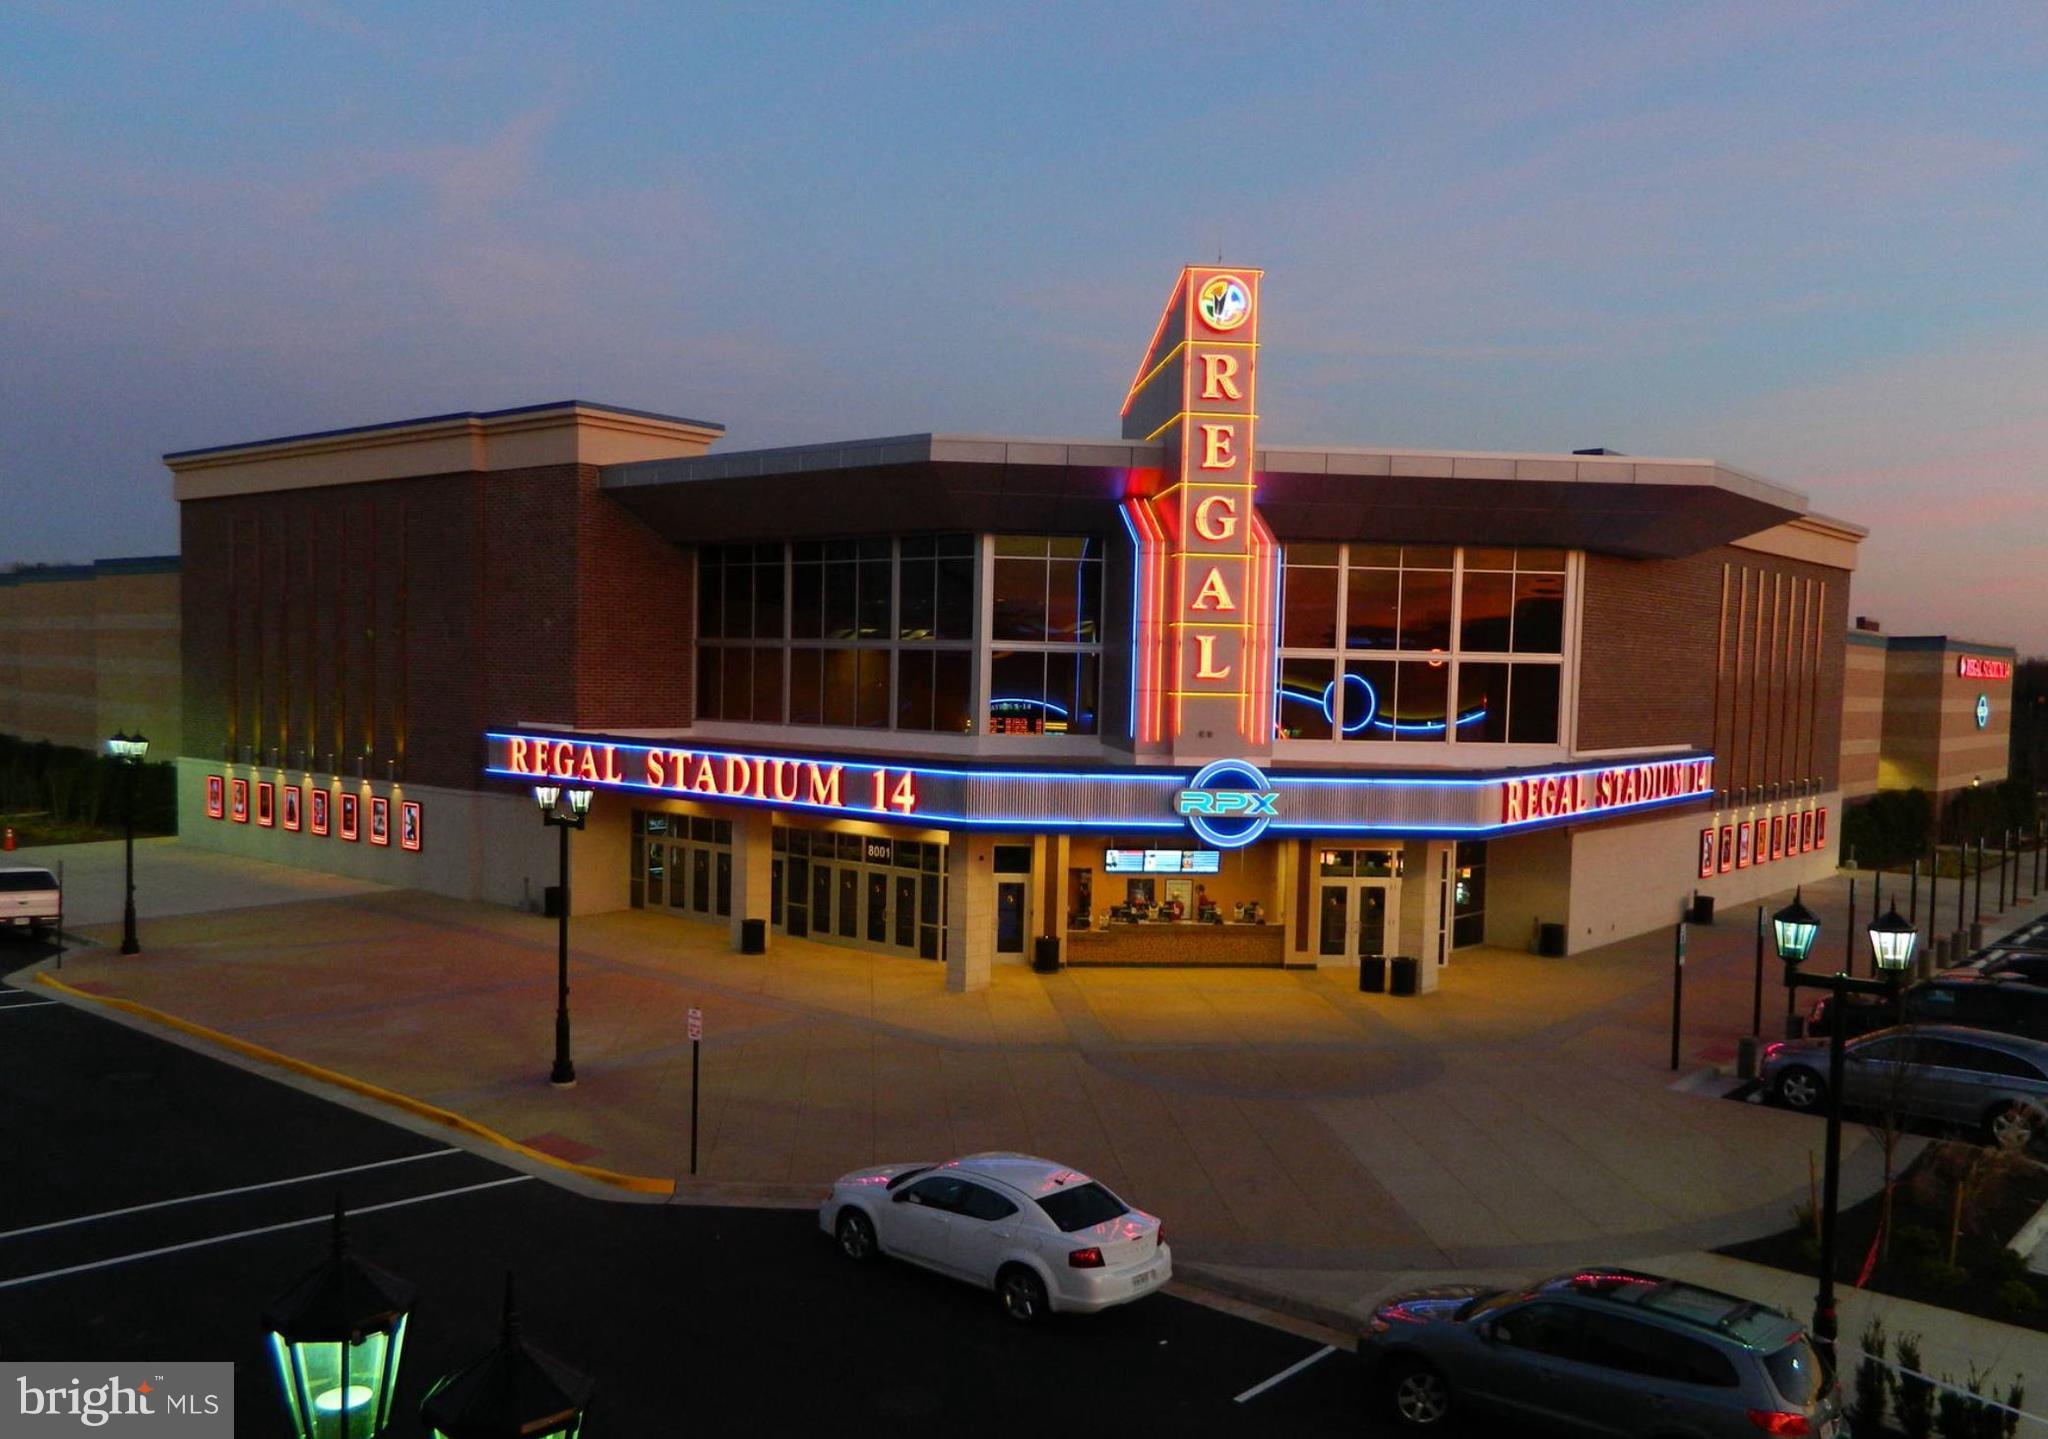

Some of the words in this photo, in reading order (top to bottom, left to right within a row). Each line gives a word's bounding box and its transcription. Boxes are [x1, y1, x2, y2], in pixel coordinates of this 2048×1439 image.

[1192, 353, 1243, 682] REGAL
[508, 737, 623, 785] REGAL
[646, 747, 843, 808] STADIUM
[872, 767, 917, 816] 14
[1180, 791, 1280, 815] RPX
[1506, 774, 1588, 823] REGAL
[1600, 762, 1684, 808] STADIUM
[1692, 761, 1707, 794] 14
[868, 845, 890, 858] 8001
